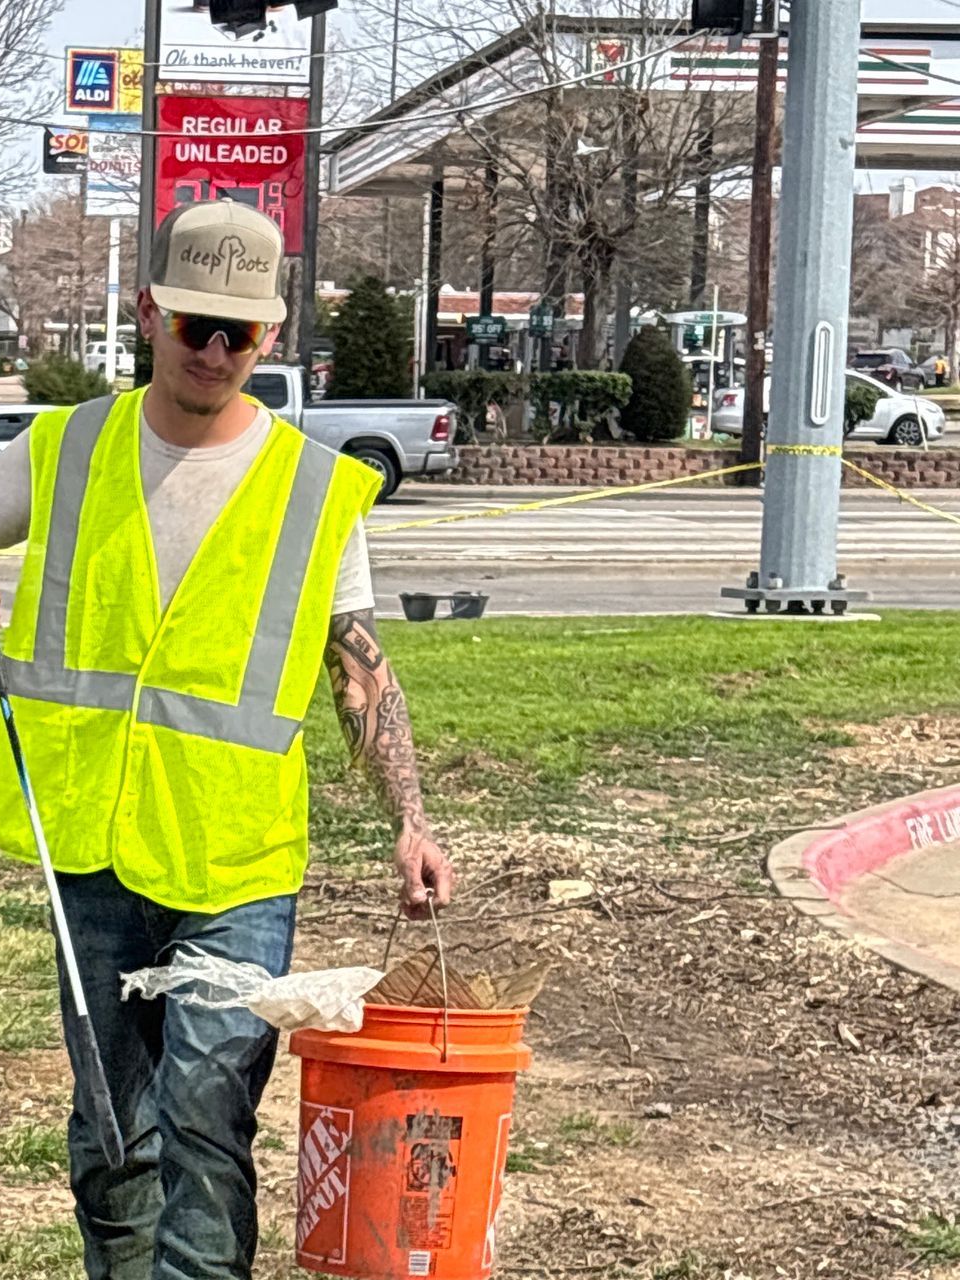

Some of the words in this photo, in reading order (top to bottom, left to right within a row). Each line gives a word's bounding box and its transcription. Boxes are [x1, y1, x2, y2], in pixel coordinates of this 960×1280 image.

[165, 48, 189, 66] Oh
[194, 52, 236, 68] thank
[241, 53, 302, 71] heaven!
[74, 88, 110, 101] ALDI
[182, 116, 283, 134] REGULAR
[175, 143, 288, 164] UNLEADED
[180, 244, 221, 275] deep
[906, 814, 941, 850] FIRE
